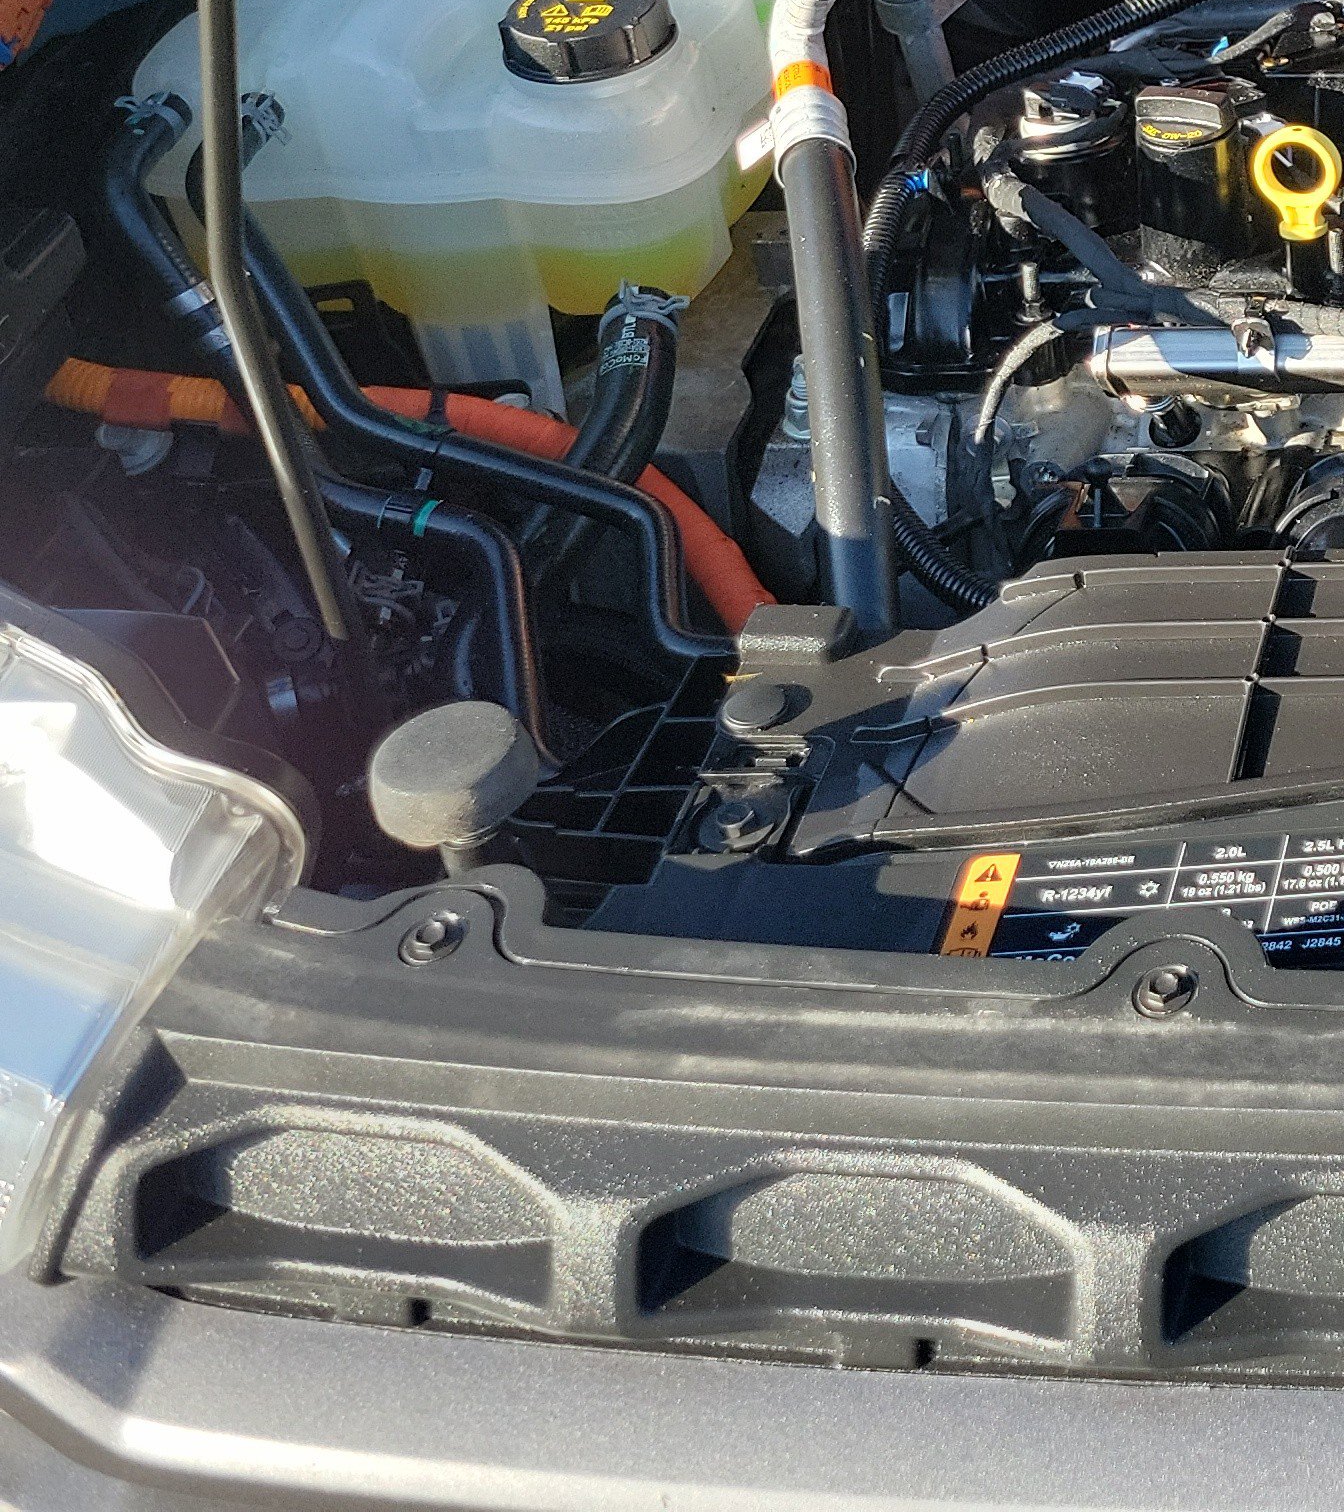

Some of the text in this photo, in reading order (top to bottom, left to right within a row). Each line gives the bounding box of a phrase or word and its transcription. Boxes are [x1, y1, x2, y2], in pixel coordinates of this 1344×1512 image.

[1214, 845, 1247, 859] 2.0L
[1303, 838, 1335, 853] 2.5L
[1303, 863, 1340, 877] 0.500
[1199, 870, 1255, 885] 0.550 kg
[1308, 878, 1322, 888] oz
[1041, 885, 1114, 904] R-1234yf
[1198, 887, 1212, 897] oz
[1214, 883, 1241, 898] (1.21
[1244, 881, 1267, 895] lbs)
[1310, 900, 1338, 913] POE
[1301, 936, 1342, 949] J2845
